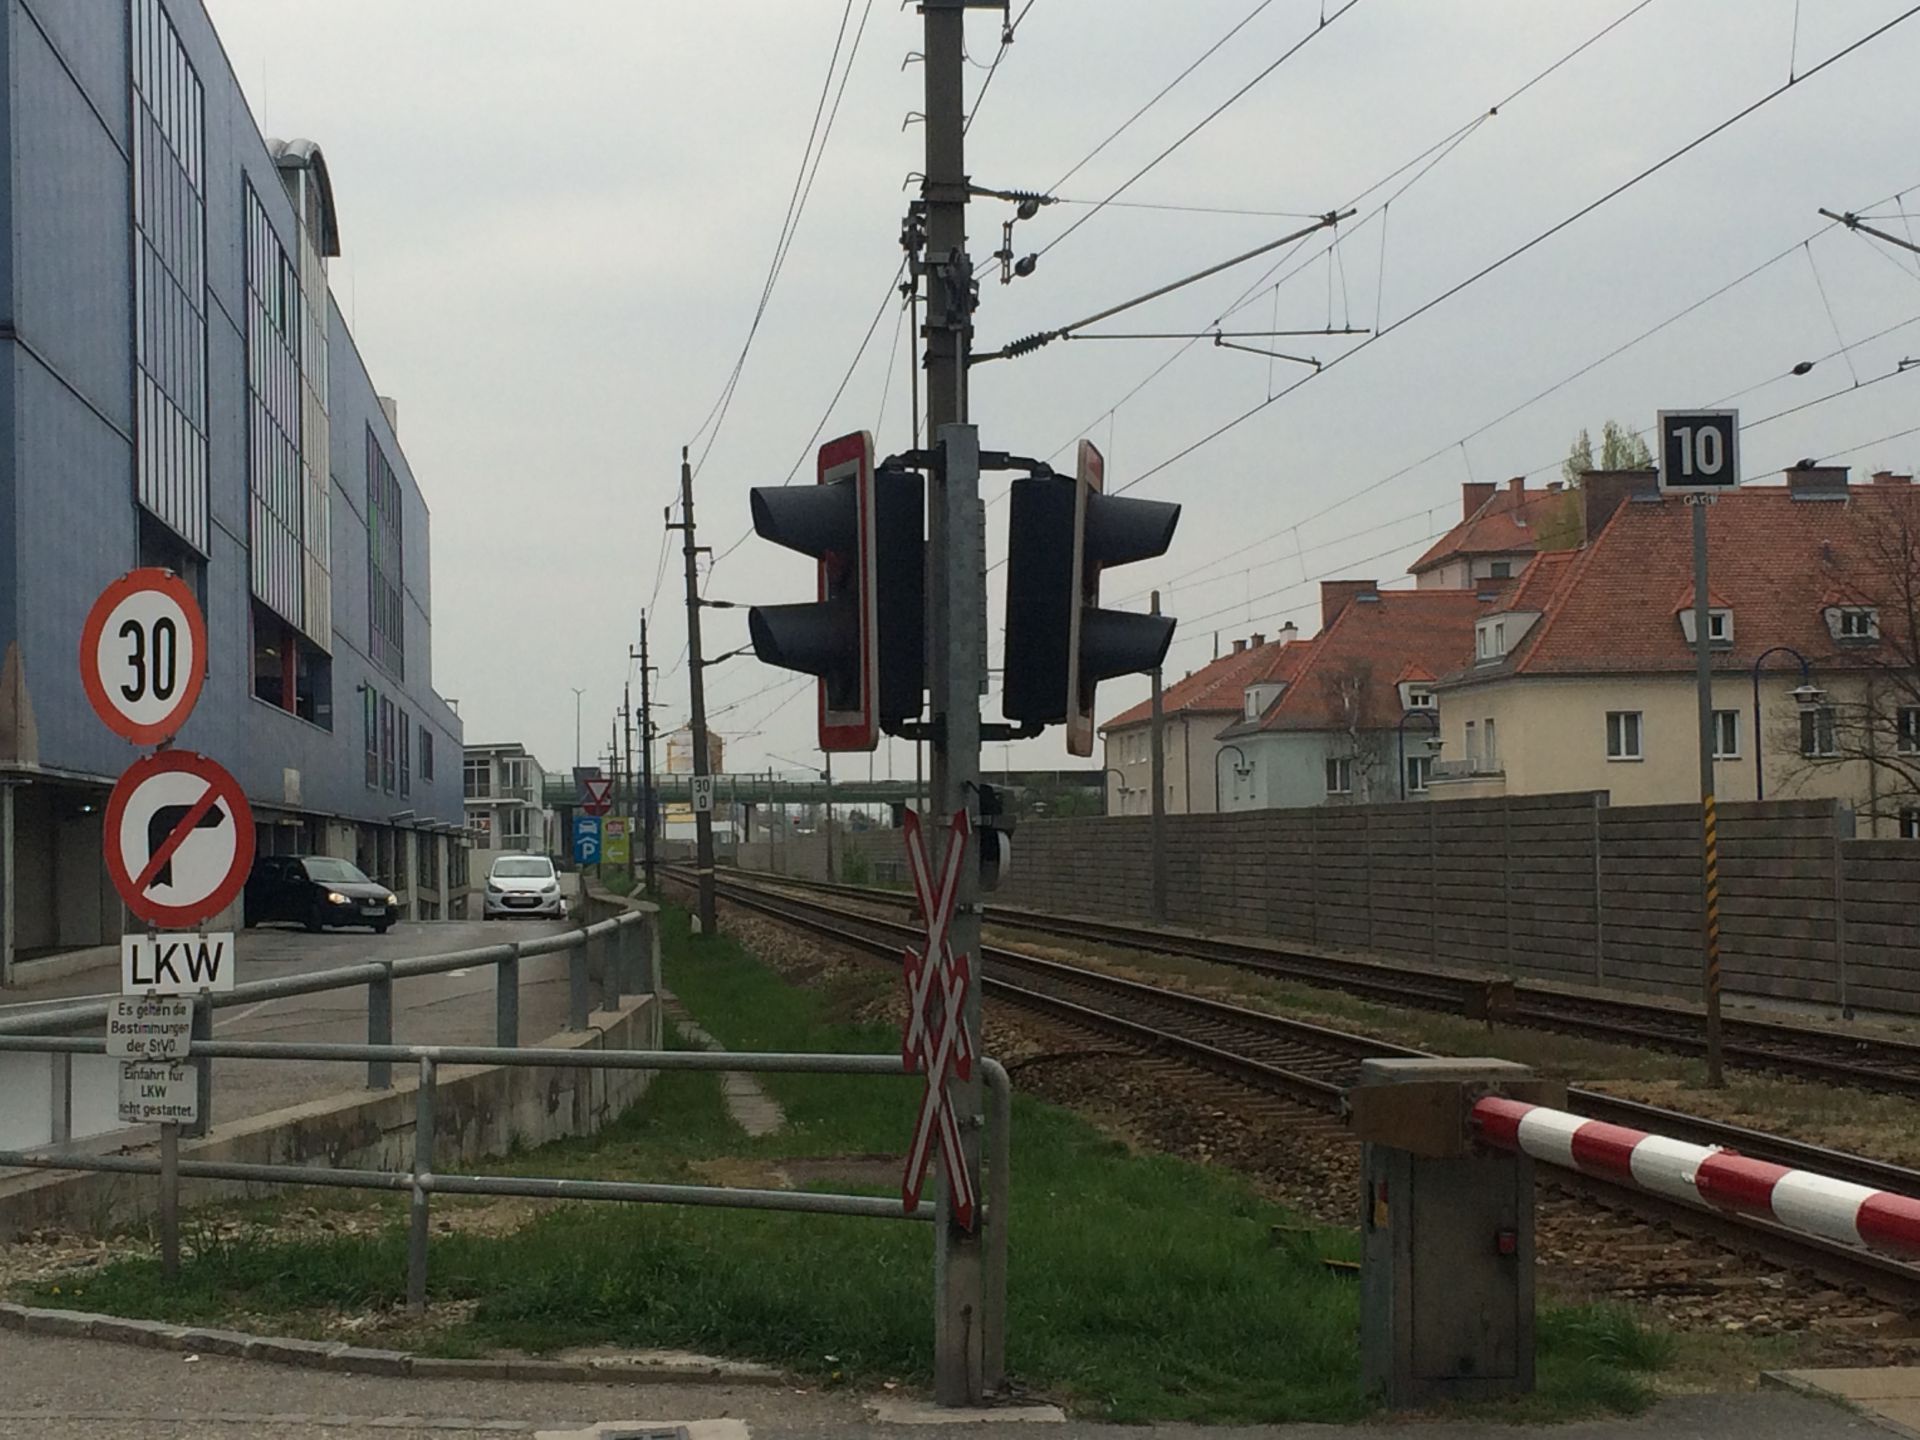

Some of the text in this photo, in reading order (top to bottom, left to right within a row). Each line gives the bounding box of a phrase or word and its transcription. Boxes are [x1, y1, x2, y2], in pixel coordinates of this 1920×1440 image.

[1672, 425, 1723, 476] 10
[118, 616, 177, 703] 30
[694, 779, 710, 793] 30
[131, 942, 224, 985] LKW
[118, 1002, 134, 1016] Es
[126, 1038, 146, 1052] der
[124, 1067, 165, 1080] Einfahrt
[141, 1084, 168, 1098] LKW
